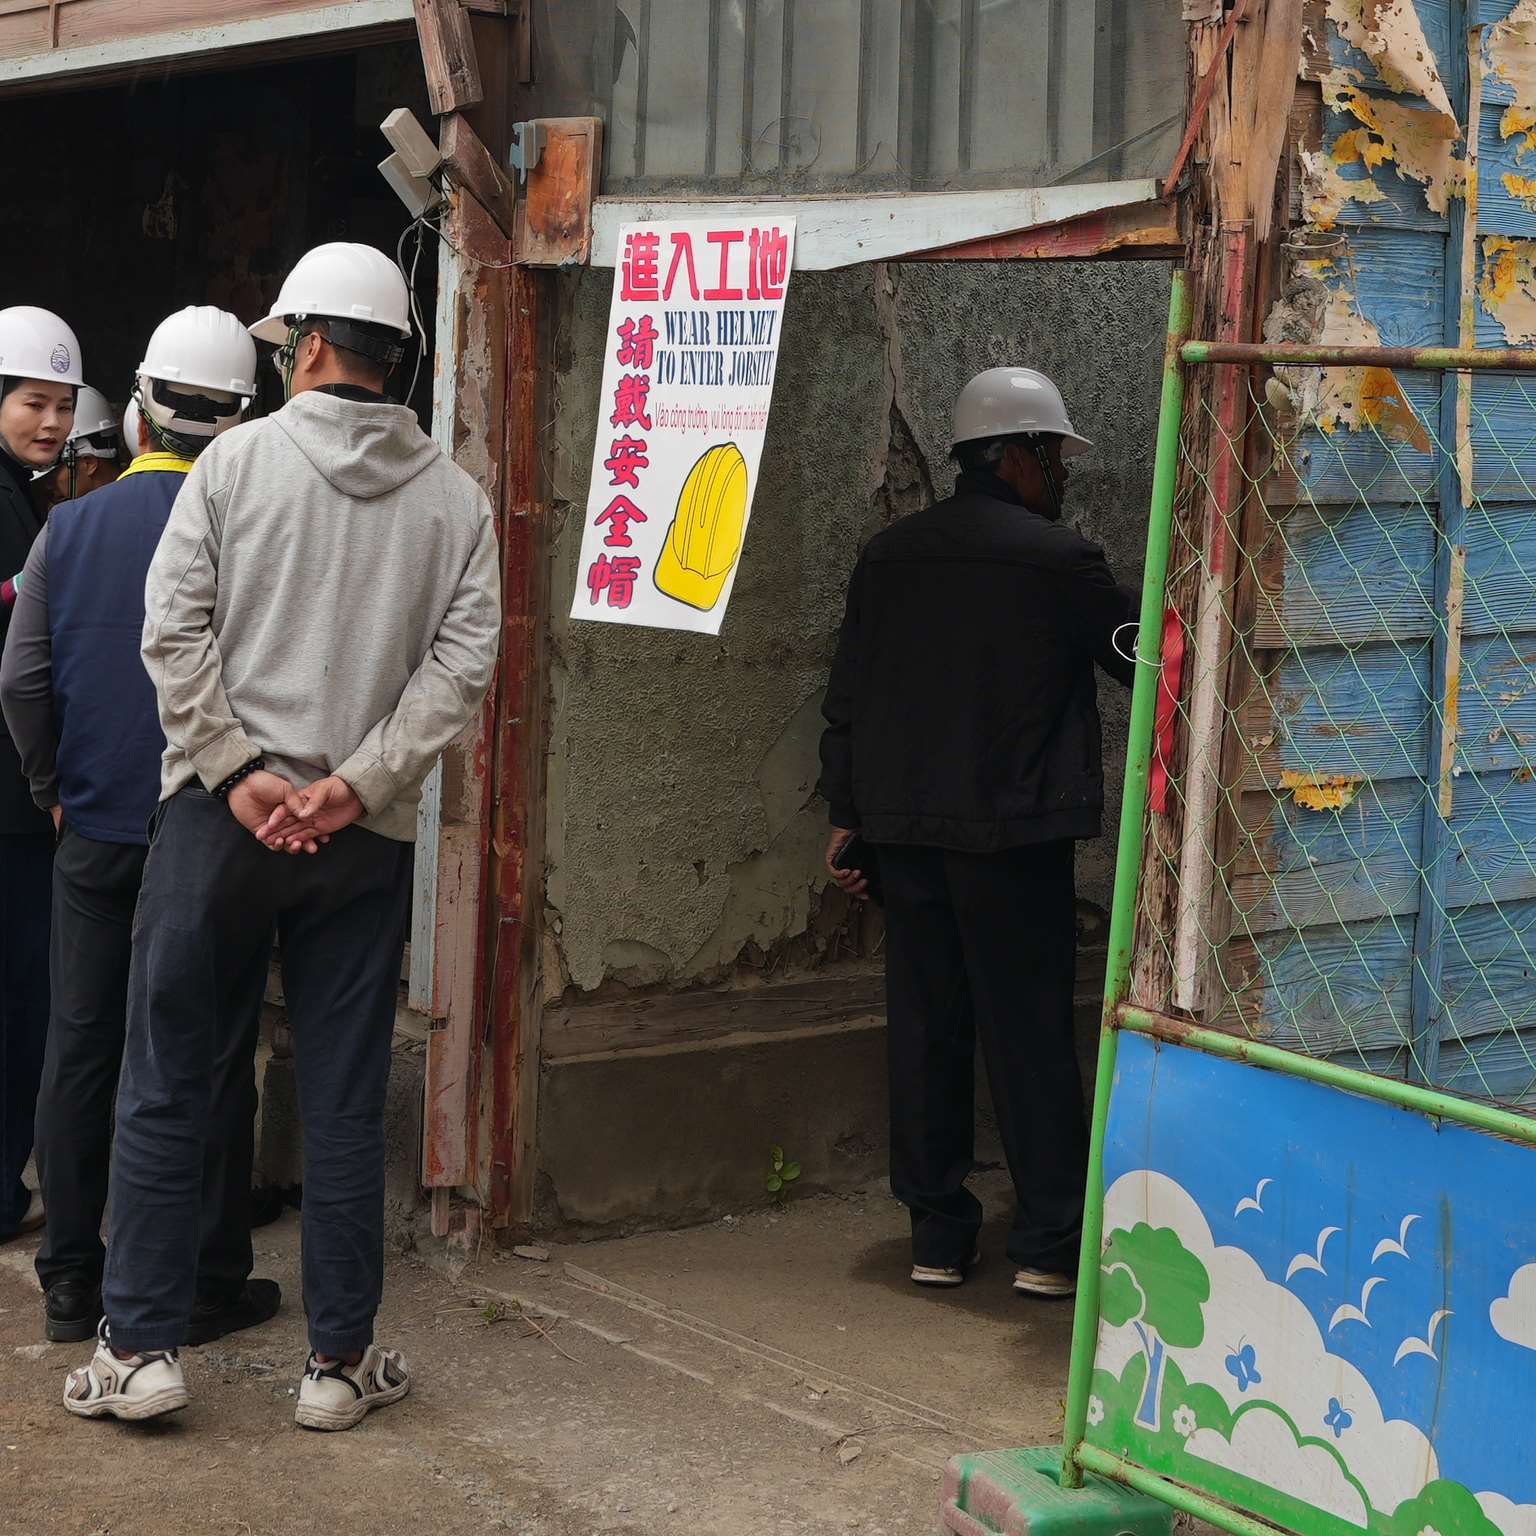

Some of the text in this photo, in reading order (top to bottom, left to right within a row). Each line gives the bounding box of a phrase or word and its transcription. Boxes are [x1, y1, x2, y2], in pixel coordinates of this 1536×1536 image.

[620, 227, 787, 301] 進入工地
[665, 310, 777, 345] WEAR HELMET
[656, 351, 774, 386] TO ENTER JOBSITE
[586, 314, 659, 609] 請戴安全帽
